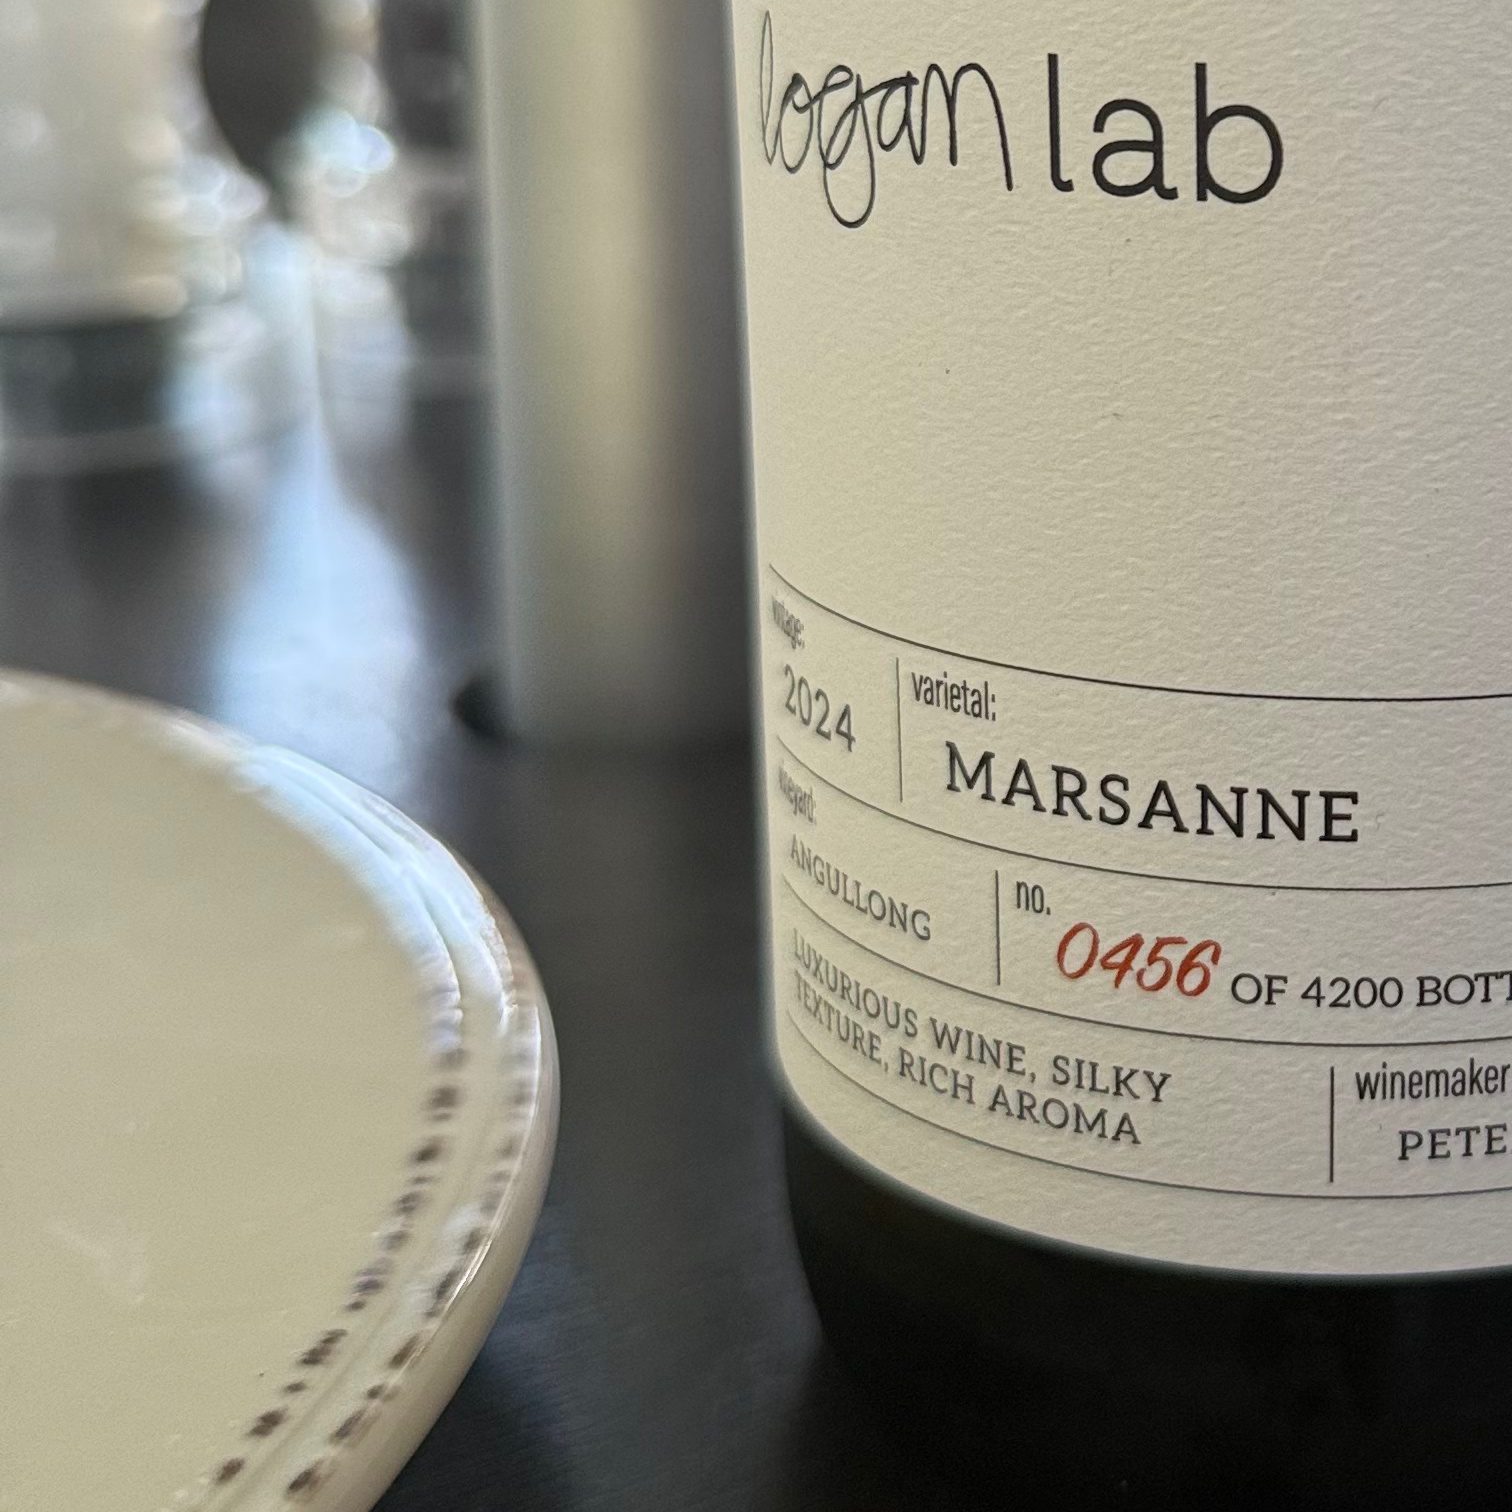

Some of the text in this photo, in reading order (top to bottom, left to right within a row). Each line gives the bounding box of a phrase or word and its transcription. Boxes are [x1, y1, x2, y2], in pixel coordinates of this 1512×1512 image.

[760, 10, 1284, 228] logan lab
[783, 663, 855, 753] 2024
[911, 671, 997, 722] varietal:
[946, 741, 1359, 842] MARSANNE
[790, 834, 932, 940] ANGULLONG
[1015, 879, 1052, 915] no.
[793, 928, 1172, 1103] LUXURIOUS WINE, SILKY
[1056, 922, 1223, 997] 0456
[1230, 973, 1289, 1006] OF
[1300, 976, 1404, 1009] 4200
[794, 970, 1143, 1145] TEXTURE, RICH AROMA
